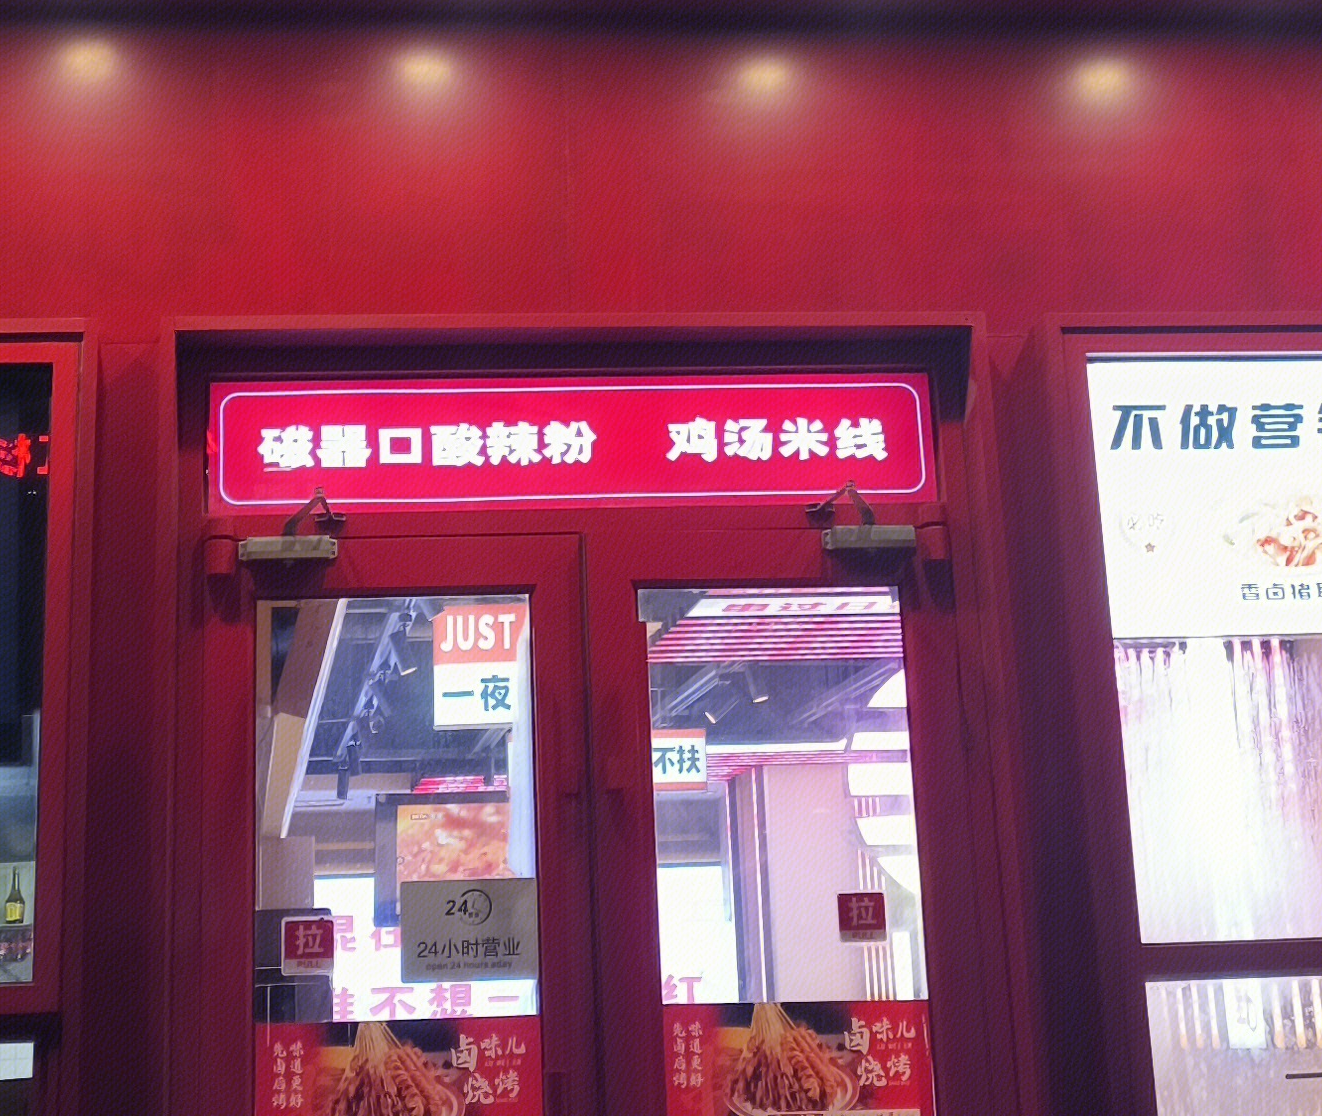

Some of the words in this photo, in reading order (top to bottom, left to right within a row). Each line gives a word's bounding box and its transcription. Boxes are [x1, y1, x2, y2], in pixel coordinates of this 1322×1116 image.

[257, 420, 598, 470] 磁器口酸辣粉
[665, 416, 890, 463] 鸡汤米线
[439, 613, 516, 653] JUST
[441, 674, 512, 712] 一夜
[652, 744, 701, 775] 不扶
[444, 899, 469, 916] 24
[848, 897, 877, 926] 拉
[295, 924, 325, 955] 拉
[416, 936, 522, 959] 24小时营业
[425, 962, 449, 972] open
[450, 961, 462, 970] 24
[463, 960, 489, 970] hours
[856, 1053, 912, 1087] 烧烤
[462, 1069, 521, 1105] 烧烤
